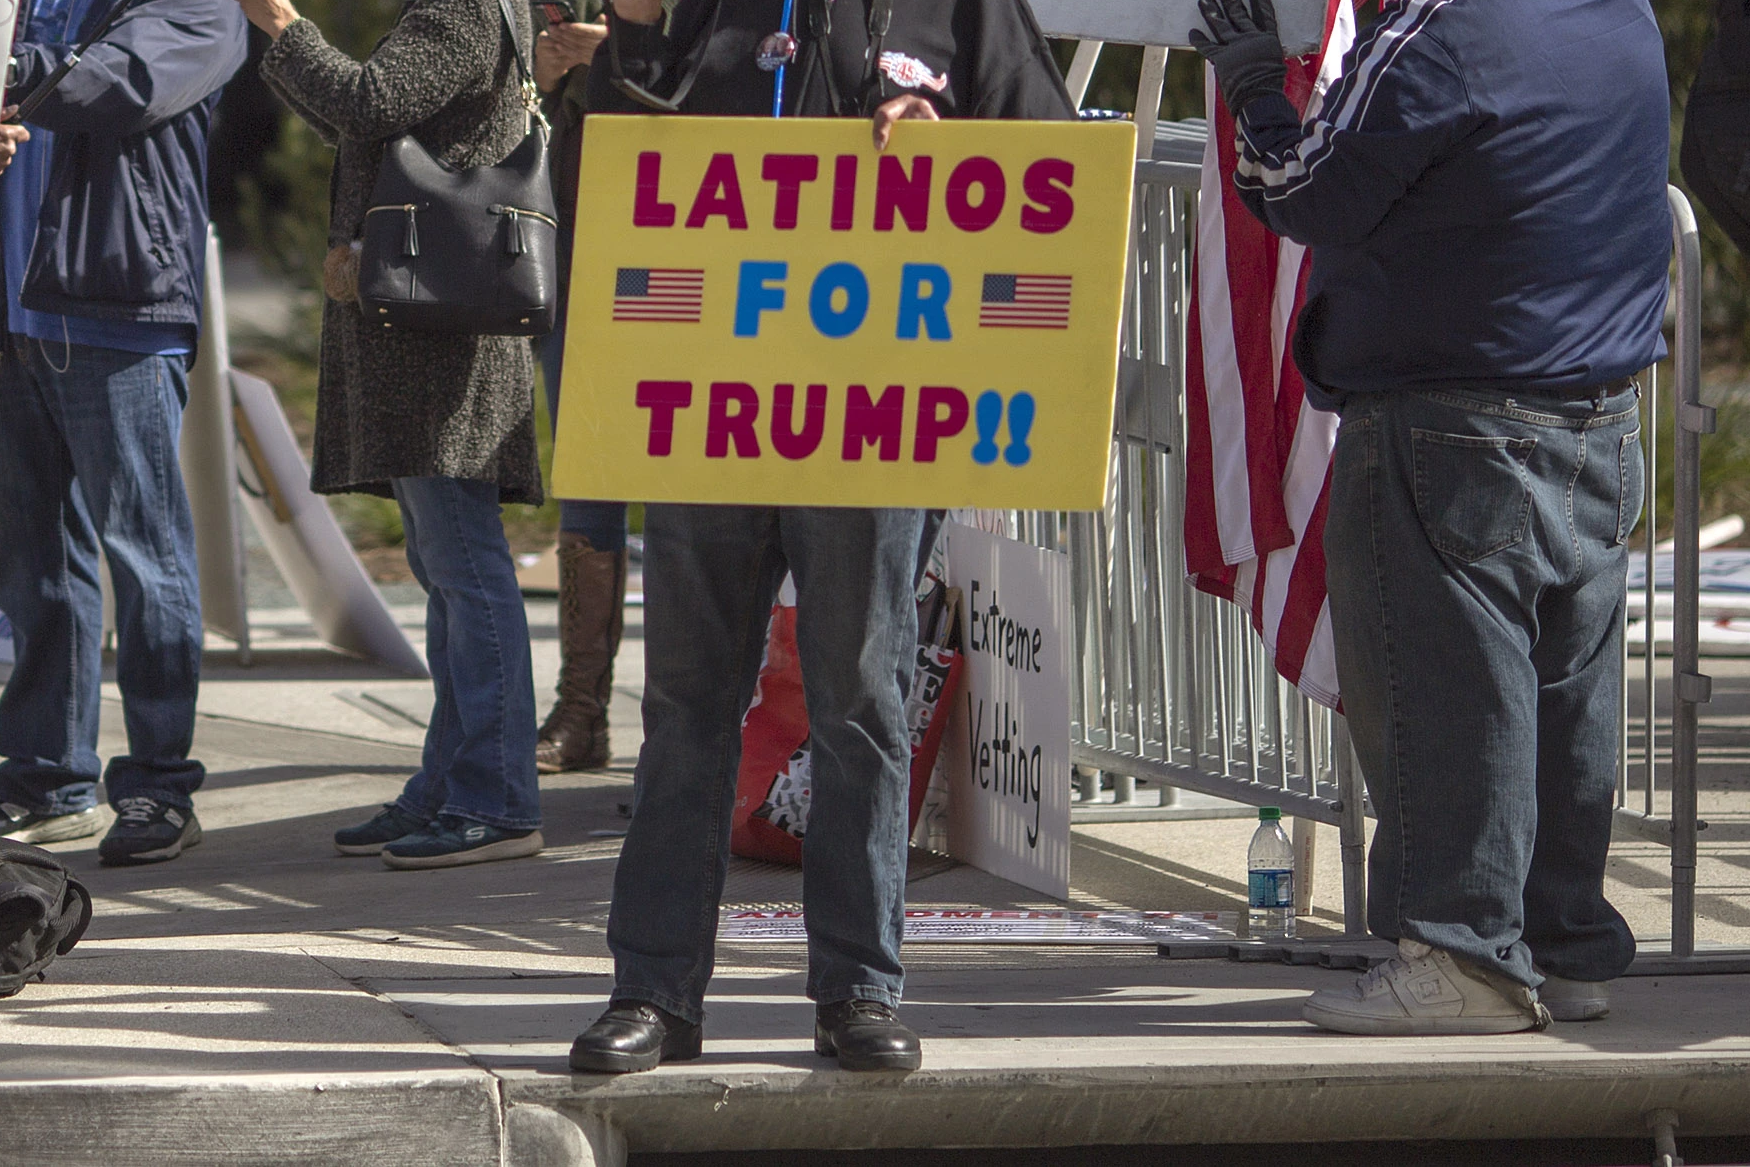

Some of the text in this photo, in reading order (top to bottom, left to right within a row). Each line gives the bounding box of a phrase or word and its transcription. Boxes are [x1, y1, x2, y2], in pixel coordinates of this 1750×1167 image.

[632, 150, 1076, 234] LATINOS
[733, 260, 953, 341] FOR
[635, 379, 1036, 468] TRUMP!!
[970, 579, 1042, 674] Extreme
[967, 691, 1042, 849] Vetting
